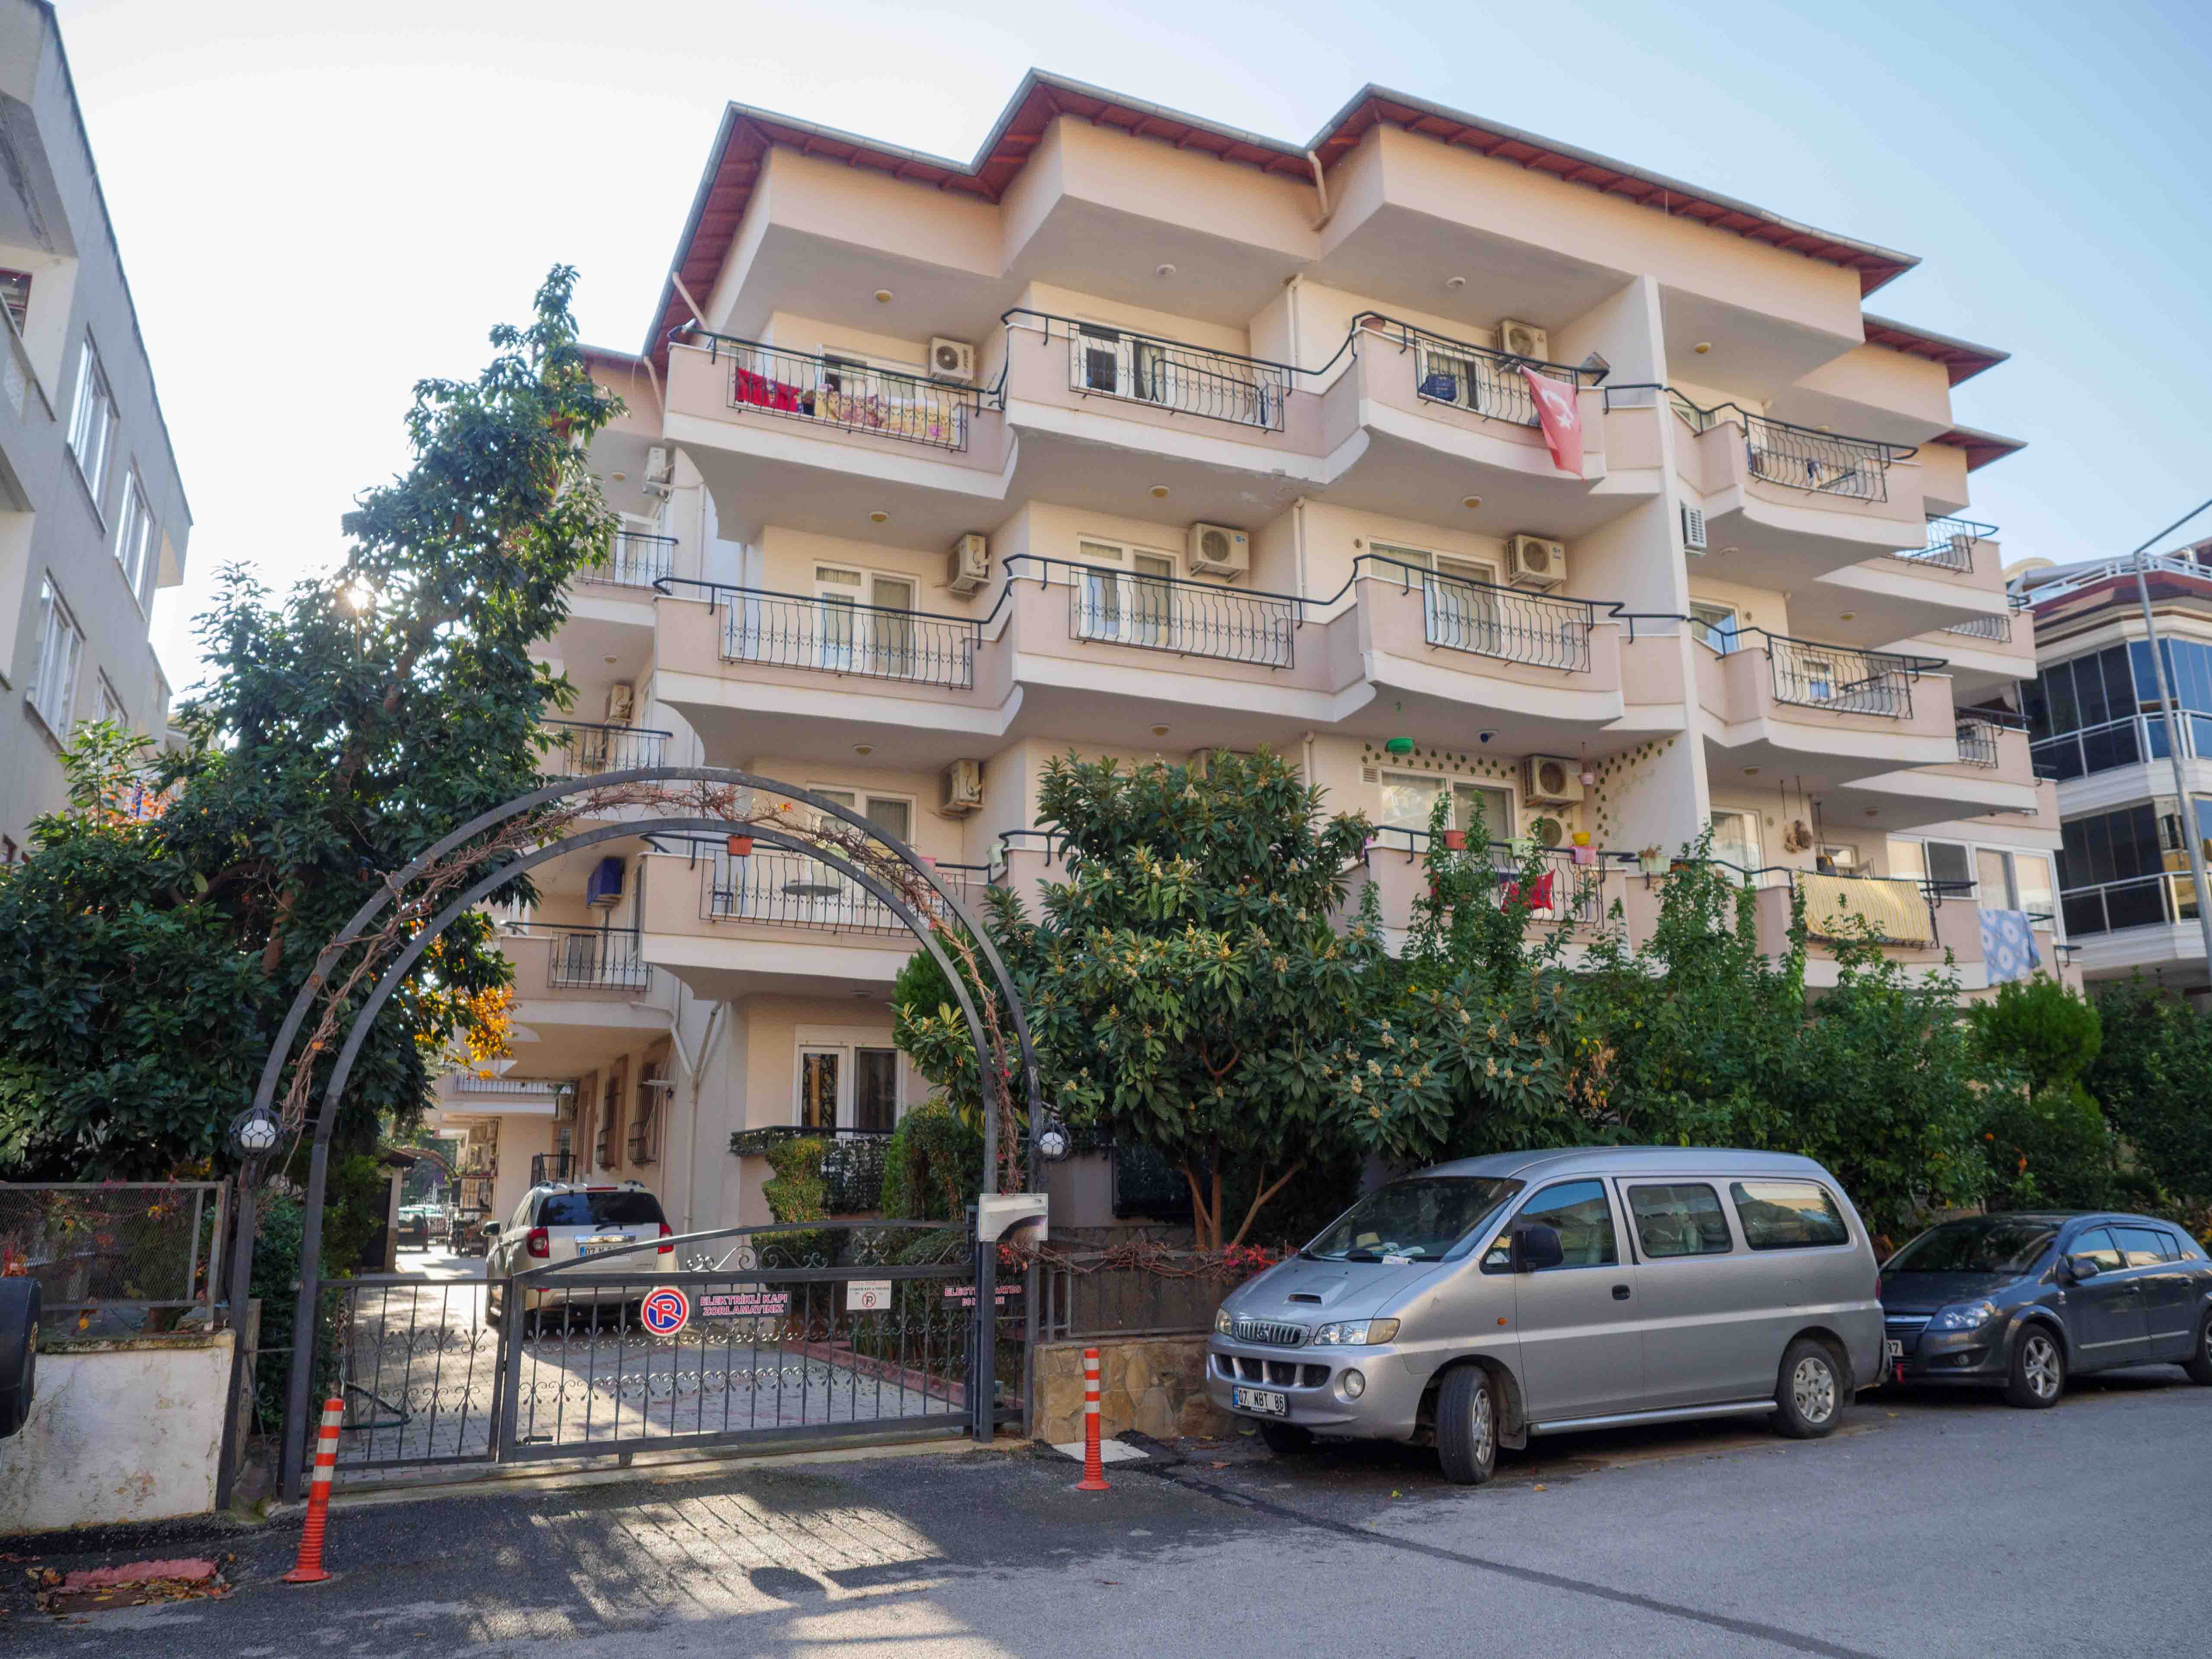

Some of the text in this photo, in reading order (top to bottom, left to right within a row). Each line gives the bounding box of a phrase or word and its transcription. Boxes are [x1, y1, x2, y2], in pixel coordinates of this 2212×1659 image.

[945, 1286, 976, 1297] ELECT
[762, 1294, 788, 1304] KAPI
[703, 1304, 784, 1316] ZORLAMAYINIZ
[1239, 1390, 1247, 1404] 07
[1274, 1395, 1284, 1409] 86
